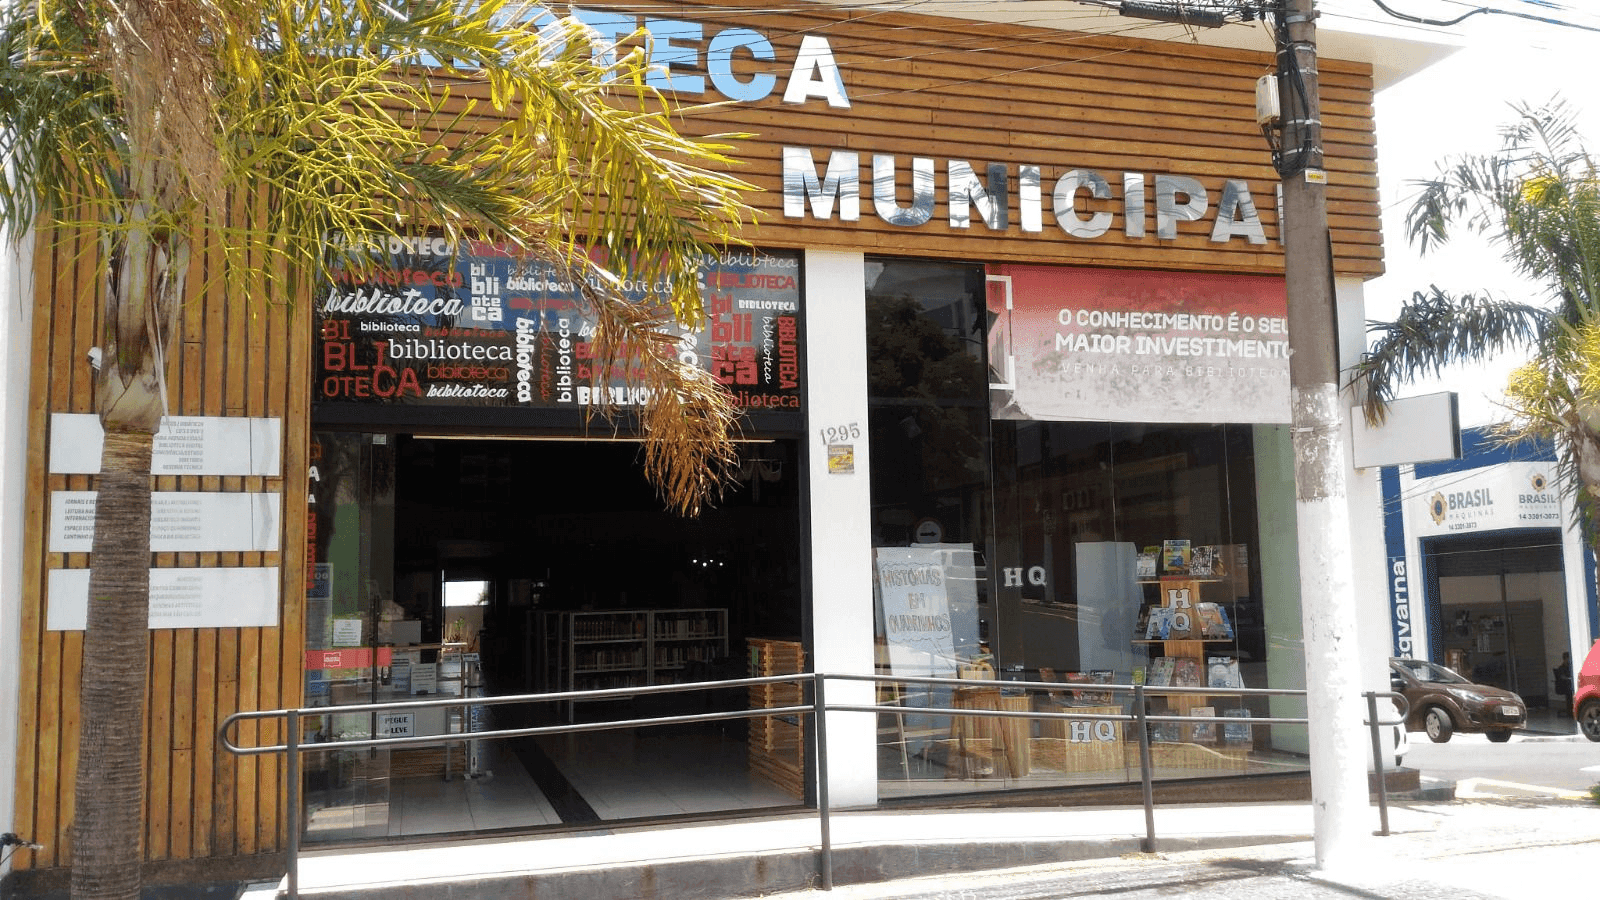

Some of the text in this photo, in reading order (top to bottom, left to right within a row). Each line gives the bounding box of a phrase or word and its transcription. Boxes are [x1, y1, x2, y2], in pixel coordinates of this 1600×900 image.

[782, 146, 1286, 246] MUNICIPA
[324, 287, 464, 316] biblioteca
[738, 299, 796, 311] BIBLIOTECA
[360, 321, 420, 333] biblioteca
[1058, 308, 1072, 326] O
[1076, 309, 1224, 332] CONHECIMENTO
[1227, 311, 1240, 333] É
[1242, 316, 1256, 333] O
[388, 338, 514, 361] biblioteca
[777, 316, 798, 389] BIBLIOTECA
[1055, 332, 1131, 355] MAIOR
[515, 317, 535, 403] biblioteca
[556, 317, 572, 403] biblioteca
[1062, 363, 1120, 375] VENHA
[1131, 365, 1176, 376] PARA
[426, 383, 509, 399] biblioteca
[820, 421, 861, 446] 1295
[1448, 487, 1494, 511] BRASIL
[1518, 494, 1556, 504] BRASIL
[1003, 566, 1048, 588] HQ
[1070, 720, 1117, 743] HQ
